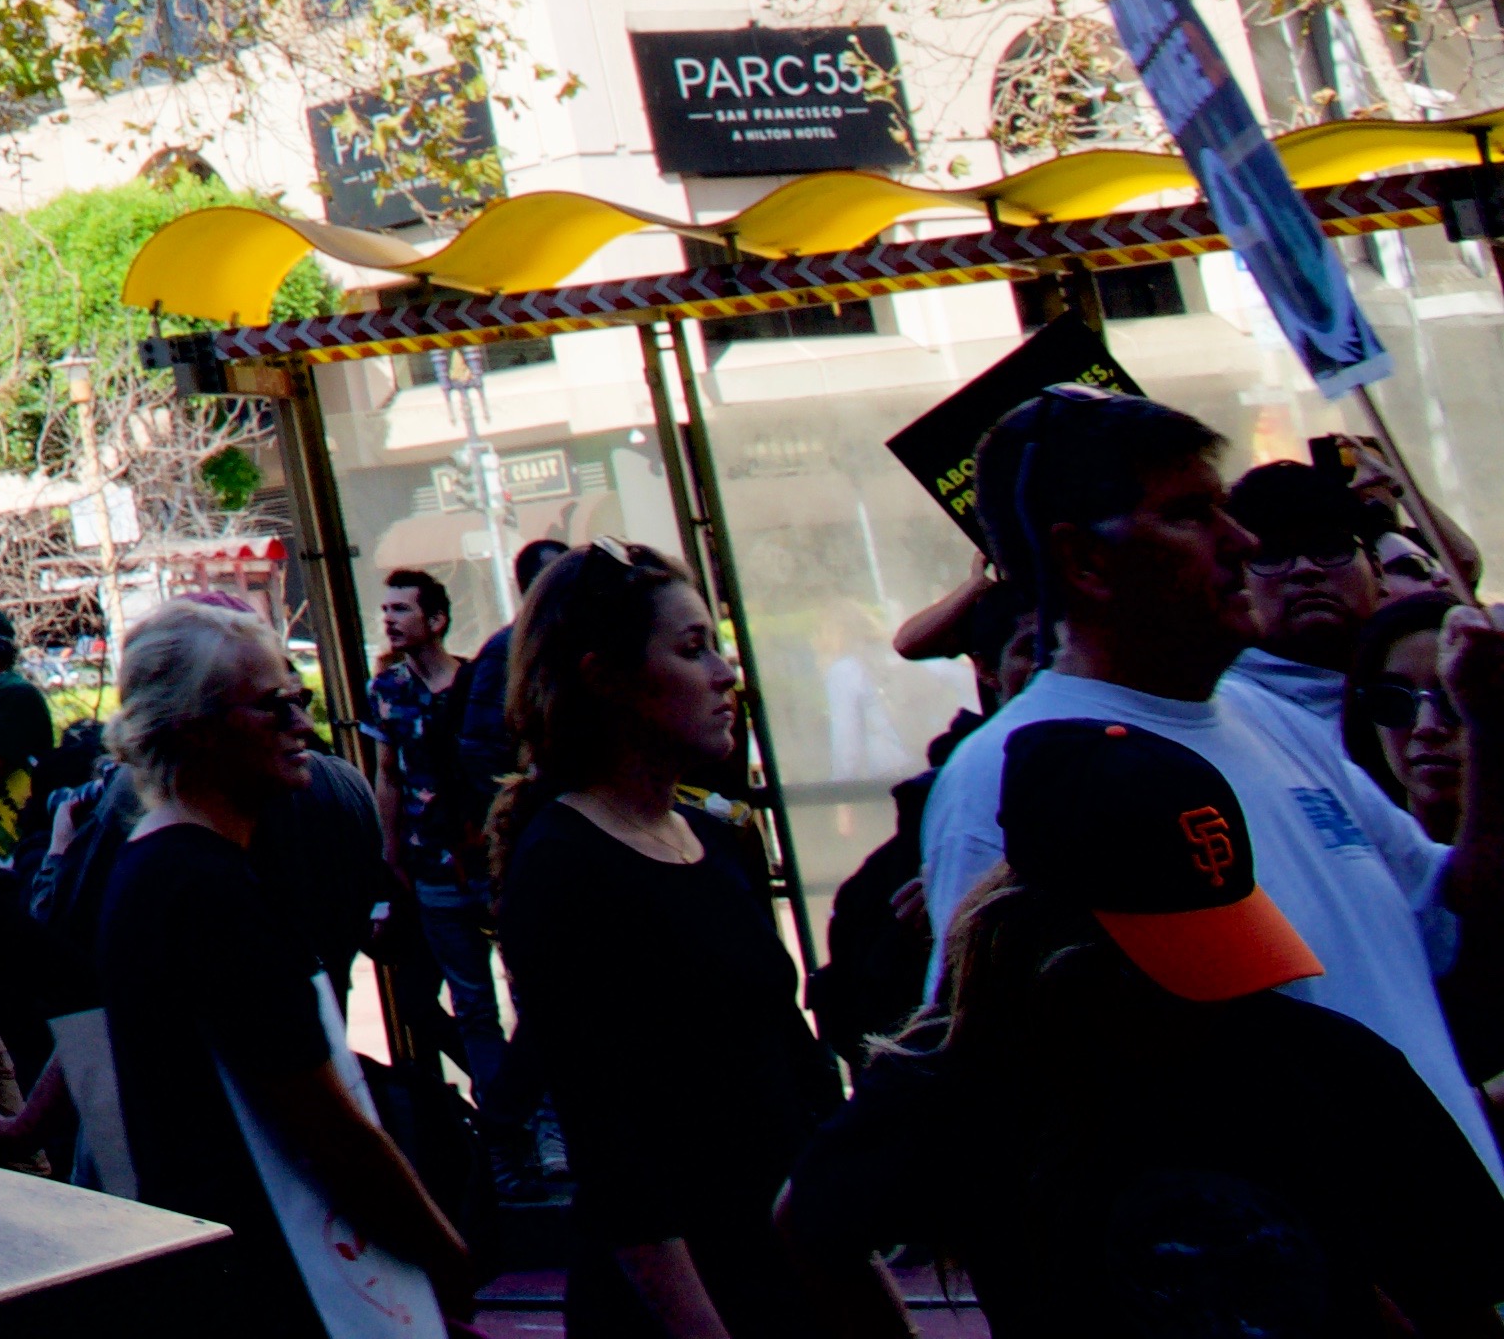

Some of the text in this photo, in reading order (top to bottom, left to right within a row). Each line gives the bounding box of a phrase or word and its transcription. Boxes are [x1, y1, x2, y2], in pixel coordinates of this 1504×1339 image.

[674, 53, 865, 100] PARC 55
[713, 105, 844, 123] SAN FRANCISCO
[731, 126, 838, 142] A HILTON HOTEL
[1178, 806, 1235, 888] SF
